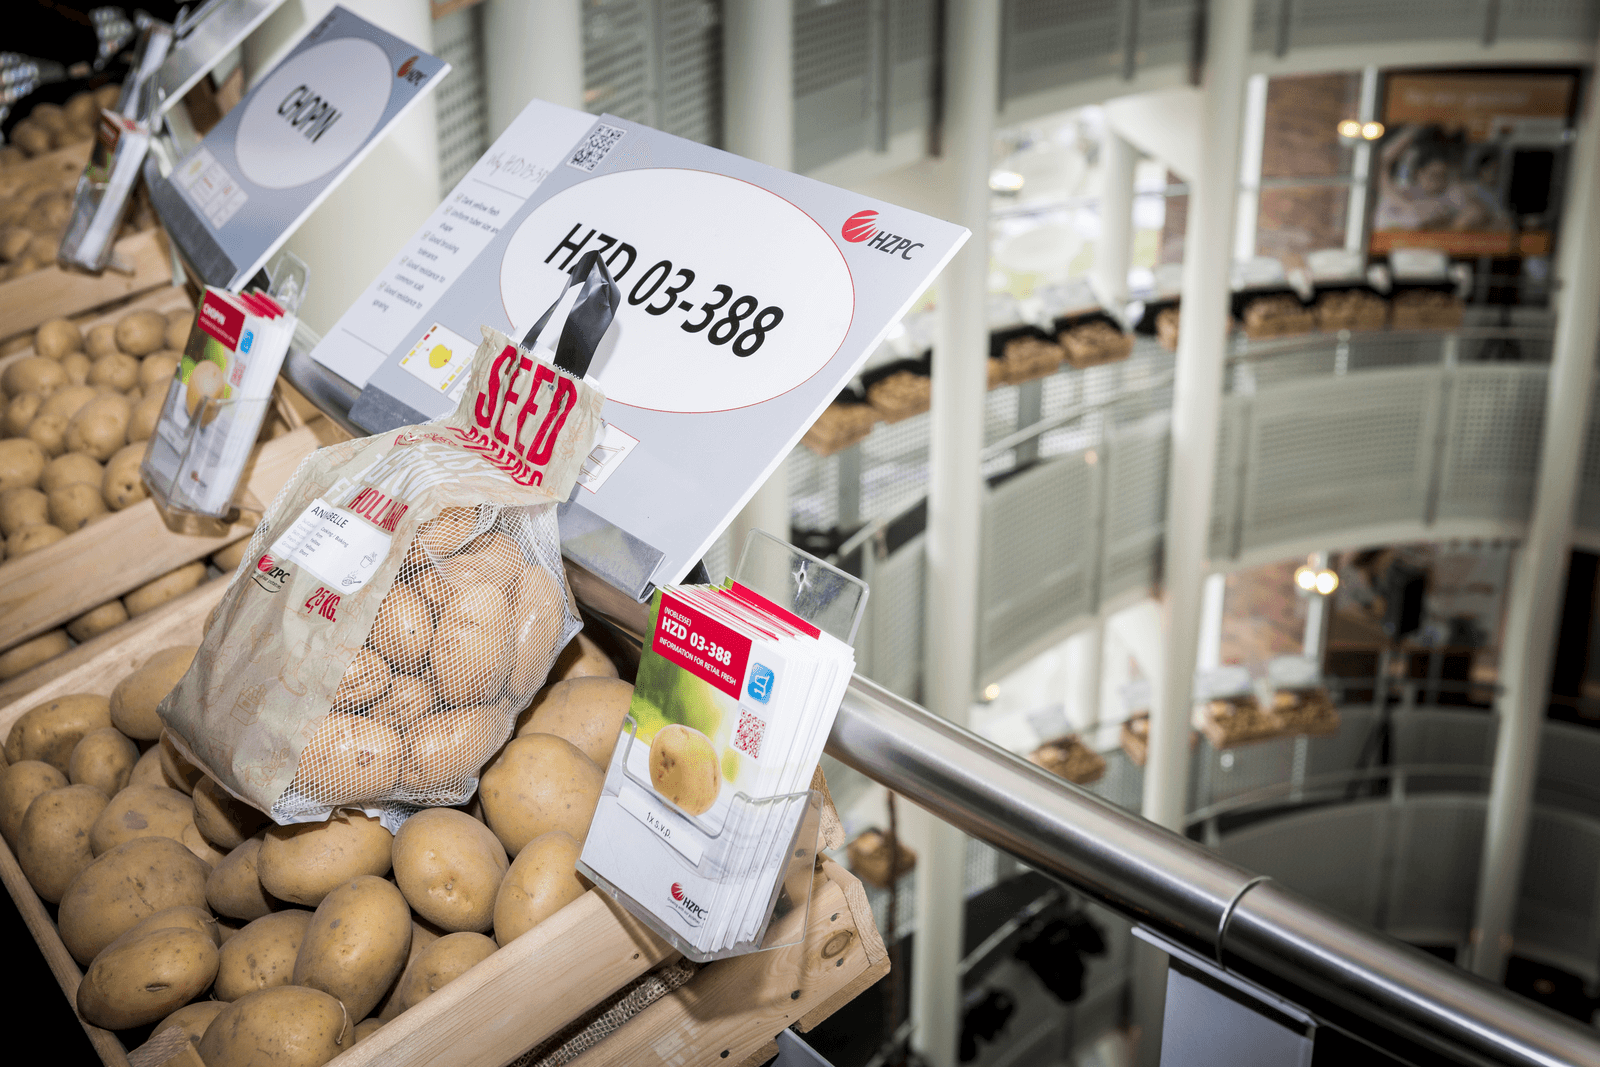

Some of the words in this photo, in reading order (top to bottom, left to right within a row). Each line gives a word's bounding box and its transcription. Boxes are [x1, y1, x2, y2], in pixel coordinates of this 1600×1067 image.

[277, 84, 342, 144] CHOPIN
[867, 231, 925, 260] HZPC
[628, 259, 784, 358] 03-388
[475, 344, 577, 466] SEED
[348, 487, 409, 532] HOLLAND
[321, 526, 333, 537] Cooking
[267, 566, 290, 584] ZPC
[664, 606, 692, 627] (NOBLESSE)
[661, 616, 687, 640] HZD
[690, 632, 732, 666] 03-388
[659, 636, 694, 661] INFORMATION
[693, 656, 704, 667] FOR
[703, 662, 720, 677] RETAIL
[720, 671, 737, 686] FRESH
[654, 820, 671, 839] s.v.p.
[682, 897, 706, 920] HZPC
